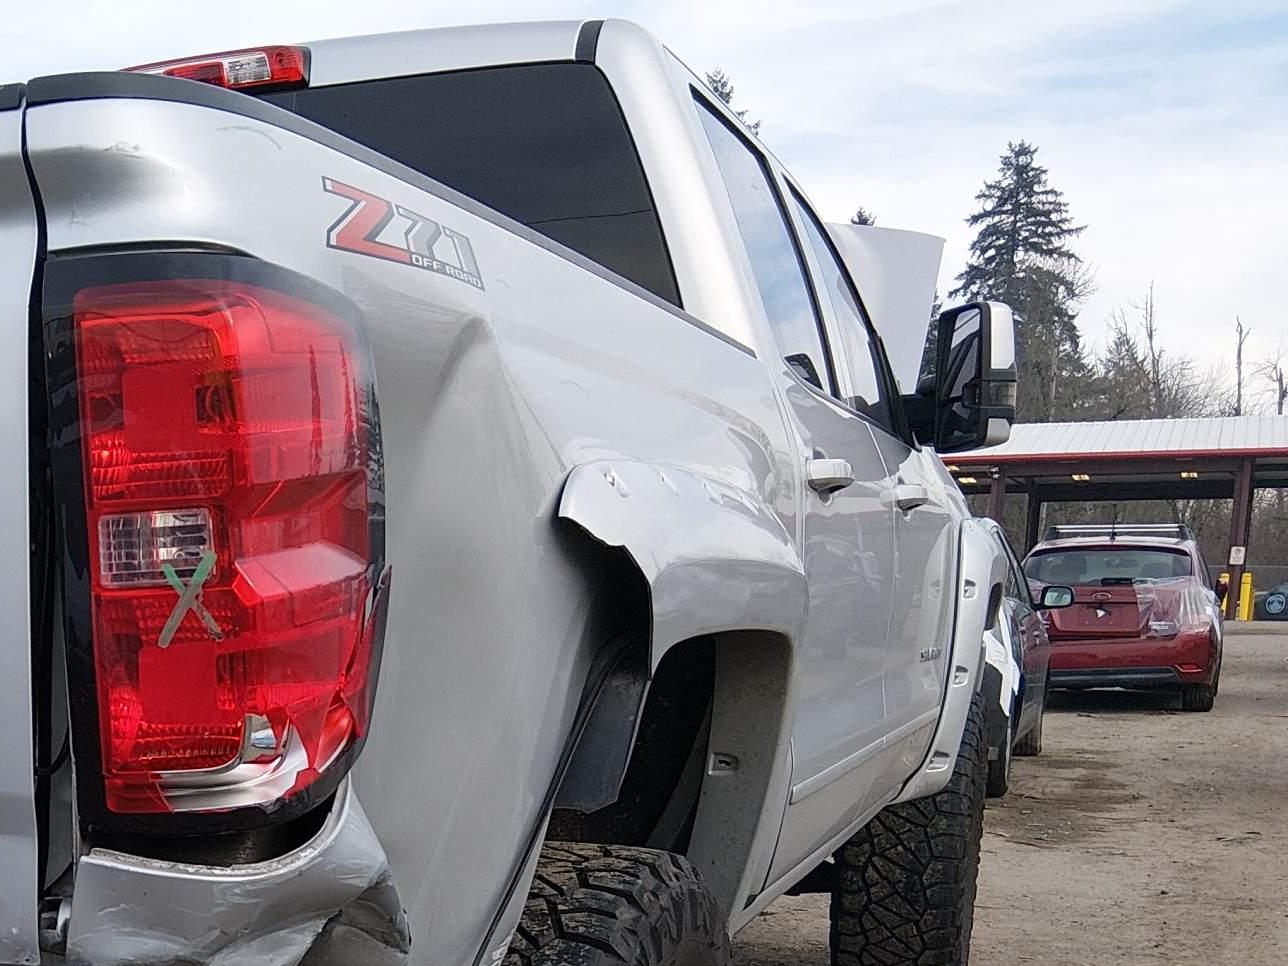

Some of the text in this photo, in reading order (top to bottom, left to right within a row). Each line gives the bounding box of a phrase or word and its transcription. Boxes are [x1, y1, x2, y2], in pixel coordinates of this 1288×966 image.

[321, 175, 482, 282] Z71
[411, 253, 482, 288] OFF ROAD
